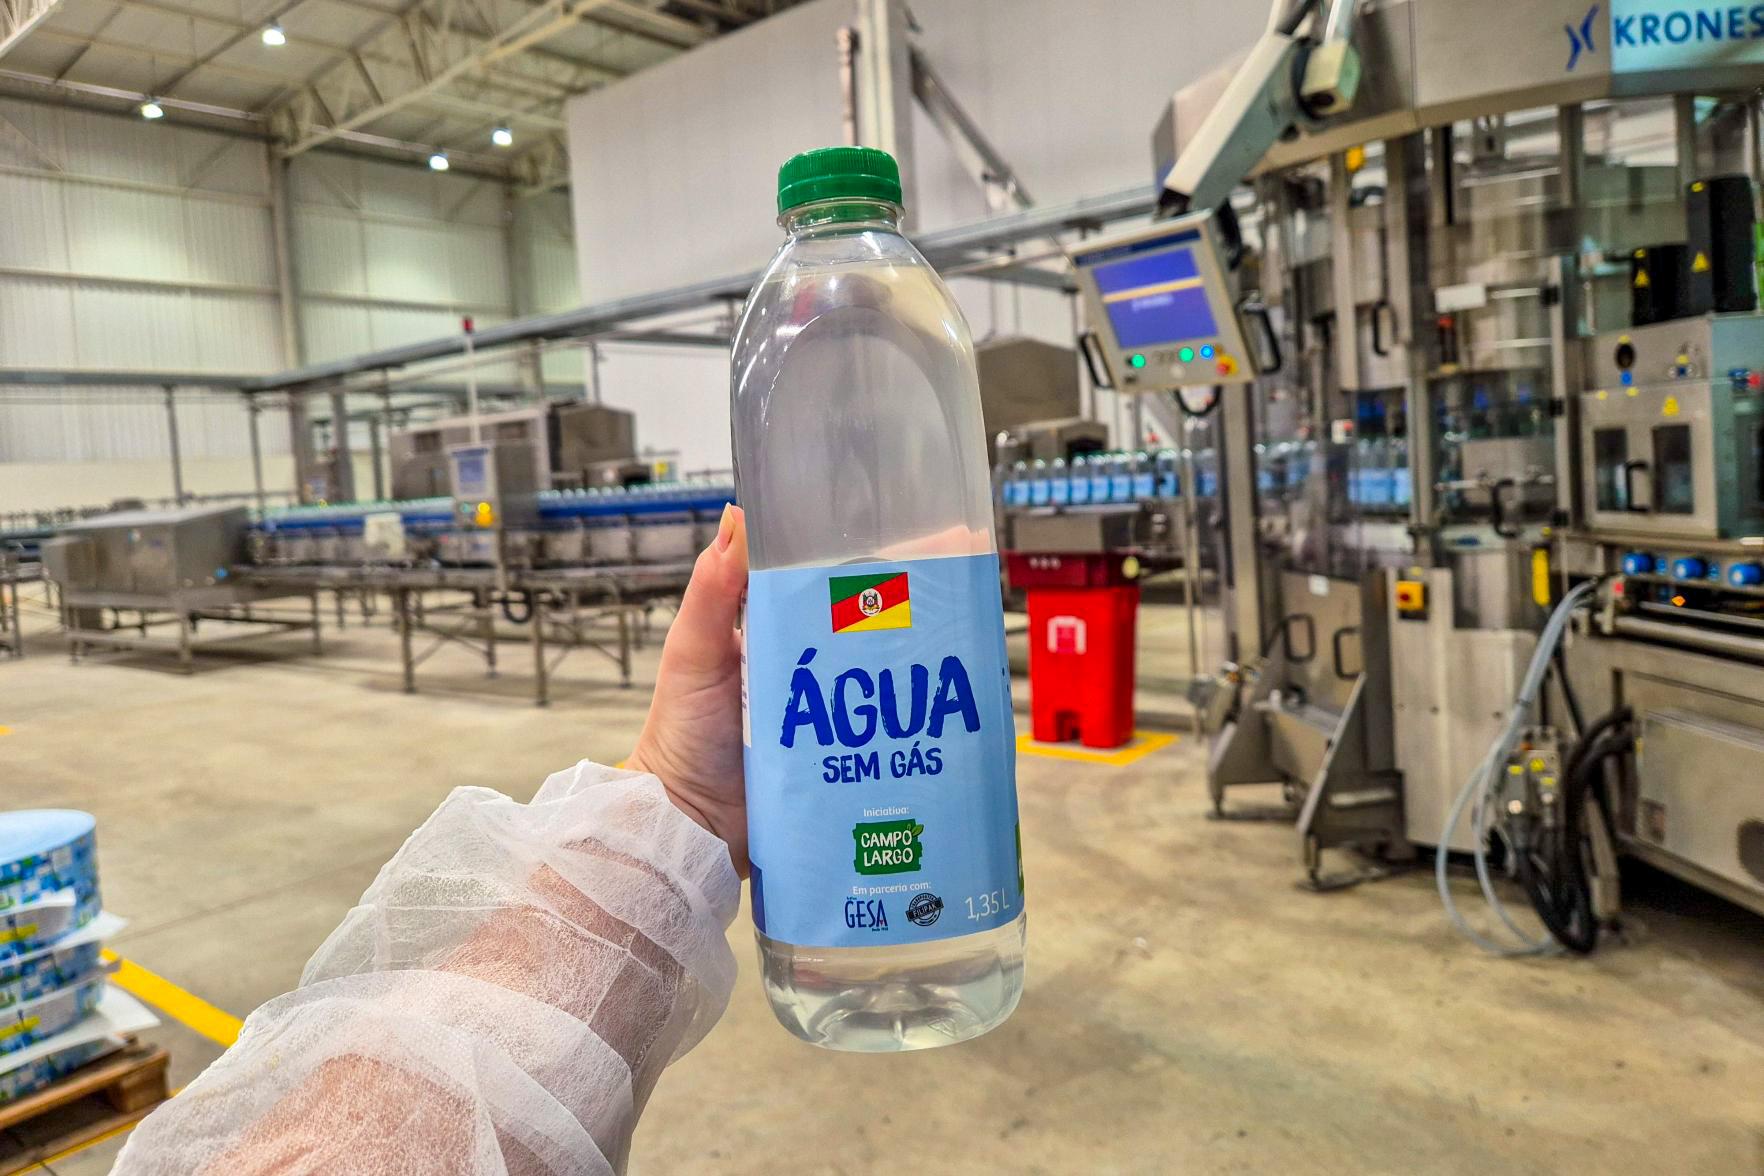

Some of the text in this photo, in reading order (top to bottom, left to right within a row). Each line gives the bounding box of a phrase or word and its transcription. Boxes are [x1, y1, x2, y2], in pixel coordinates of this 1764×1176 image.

[1613, 4, 1764, 47] KRONES
[780, 647, 981, 748] ÁGUA
[822, 741, 943, 783] SEM GÁS
[863, 806, 910, 817] Iniciativa:
[861, 830, 912, 848] CAMPO
[863, 848, 914, 867] LARGO
[852, 881, 932, 896] Em parceria com:
[844, 899, 888, 928] GESA
[965, 891, 999, 921] 1,35
[1001, 887, 1010, 909] L
